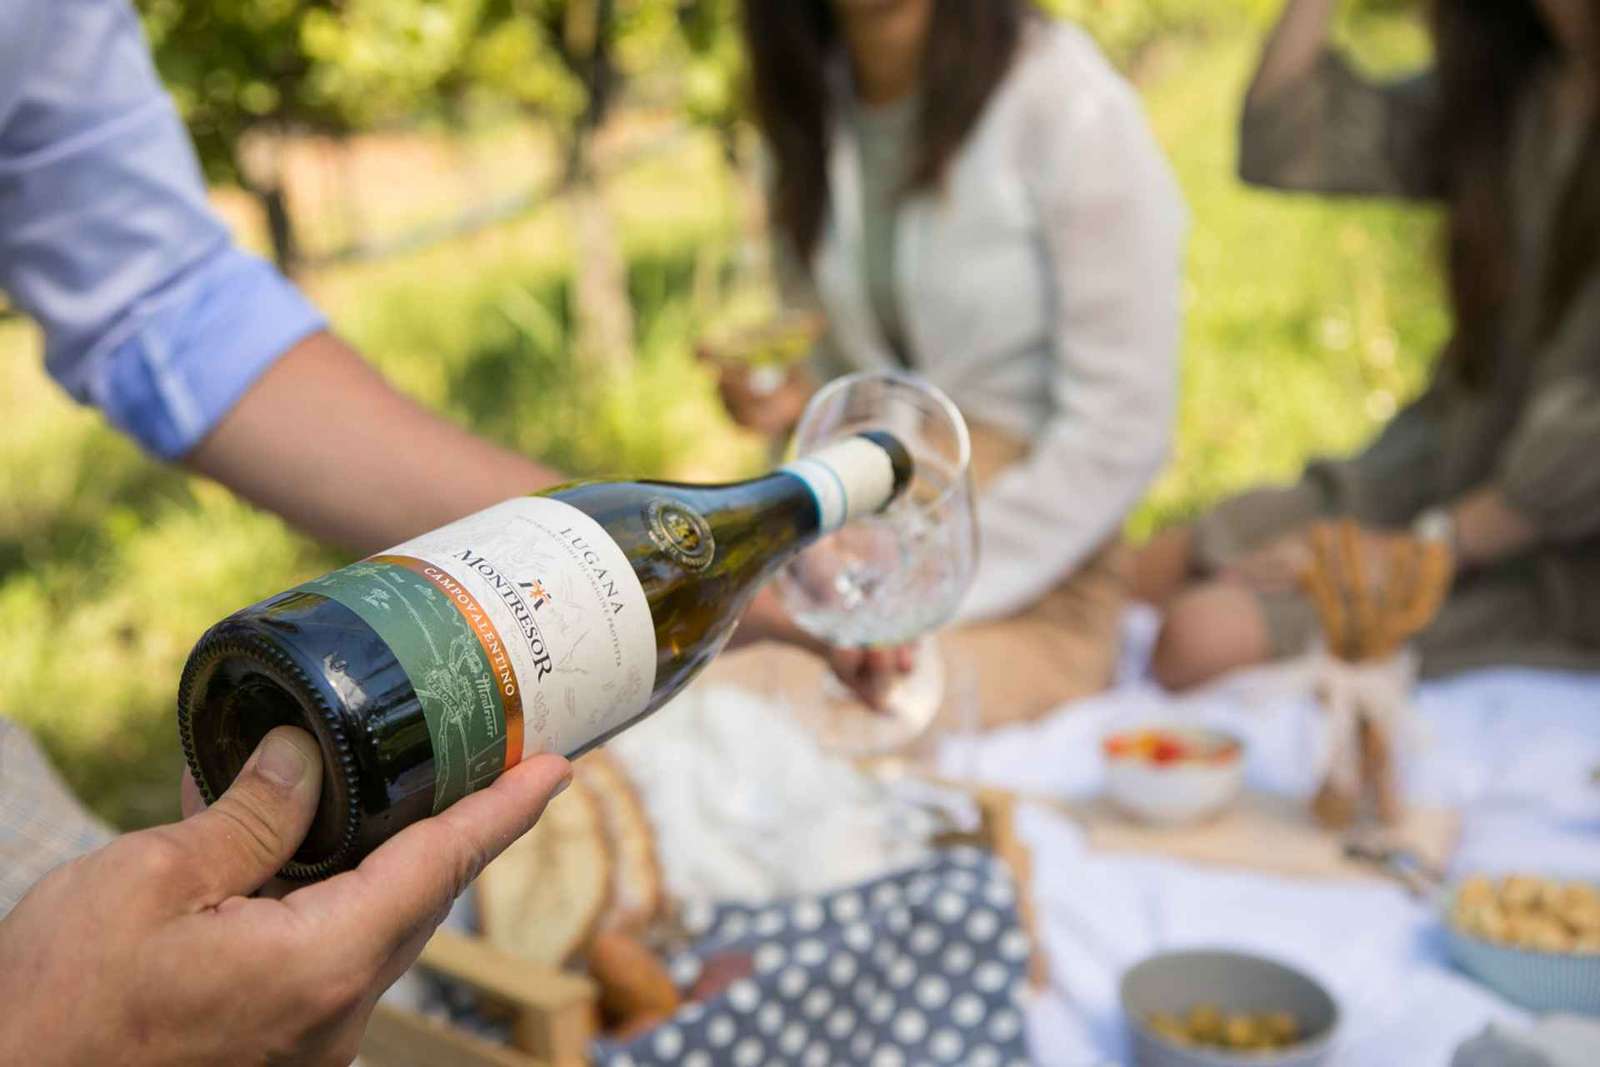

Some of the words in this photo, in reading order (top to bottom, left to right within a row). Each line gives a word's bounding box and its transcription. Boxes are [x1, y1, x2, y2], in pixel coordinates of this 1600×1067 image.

[424, 567, 514, 696] CAMPOVALENTINO
[452, 550, 552, 683] MONTRESOR
[560, 528, 624, 614] LUGANA
